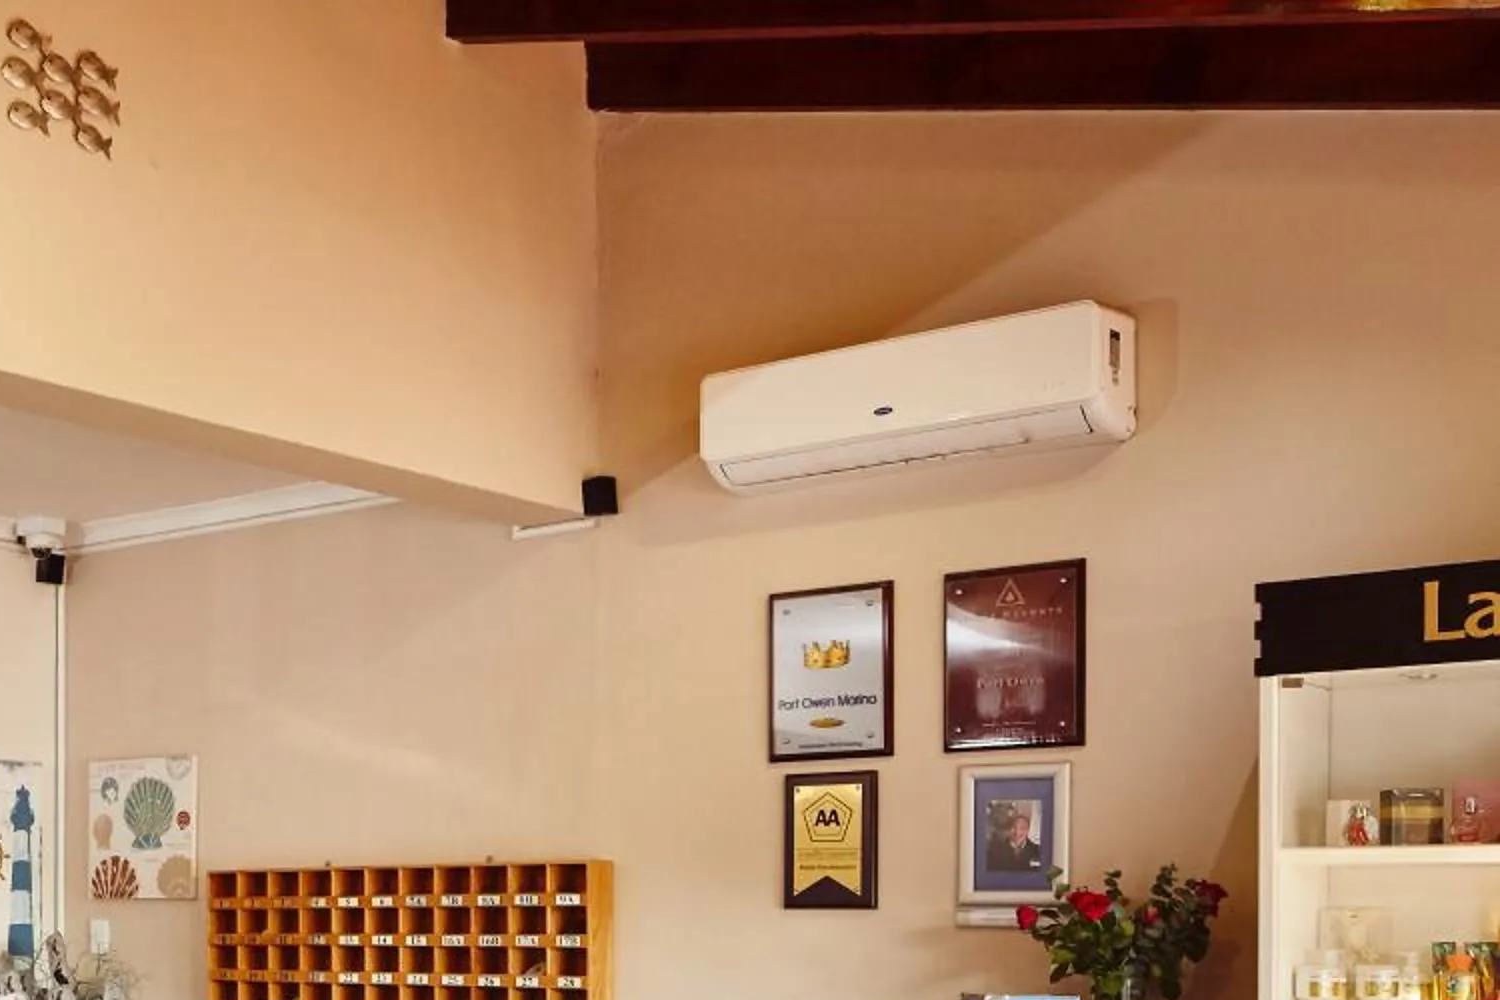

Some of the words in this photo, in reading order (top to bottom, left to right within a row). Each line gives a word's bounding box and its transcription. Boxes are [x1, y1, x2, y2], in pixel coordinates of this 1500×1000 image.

[1423, 580, 1500, 642] La
[778, 698, 800, 711] Port
[801, 697, 835, 709] Owen
[837, 694, 877, 707] Marina
[815, 809, 841, 827] AA
